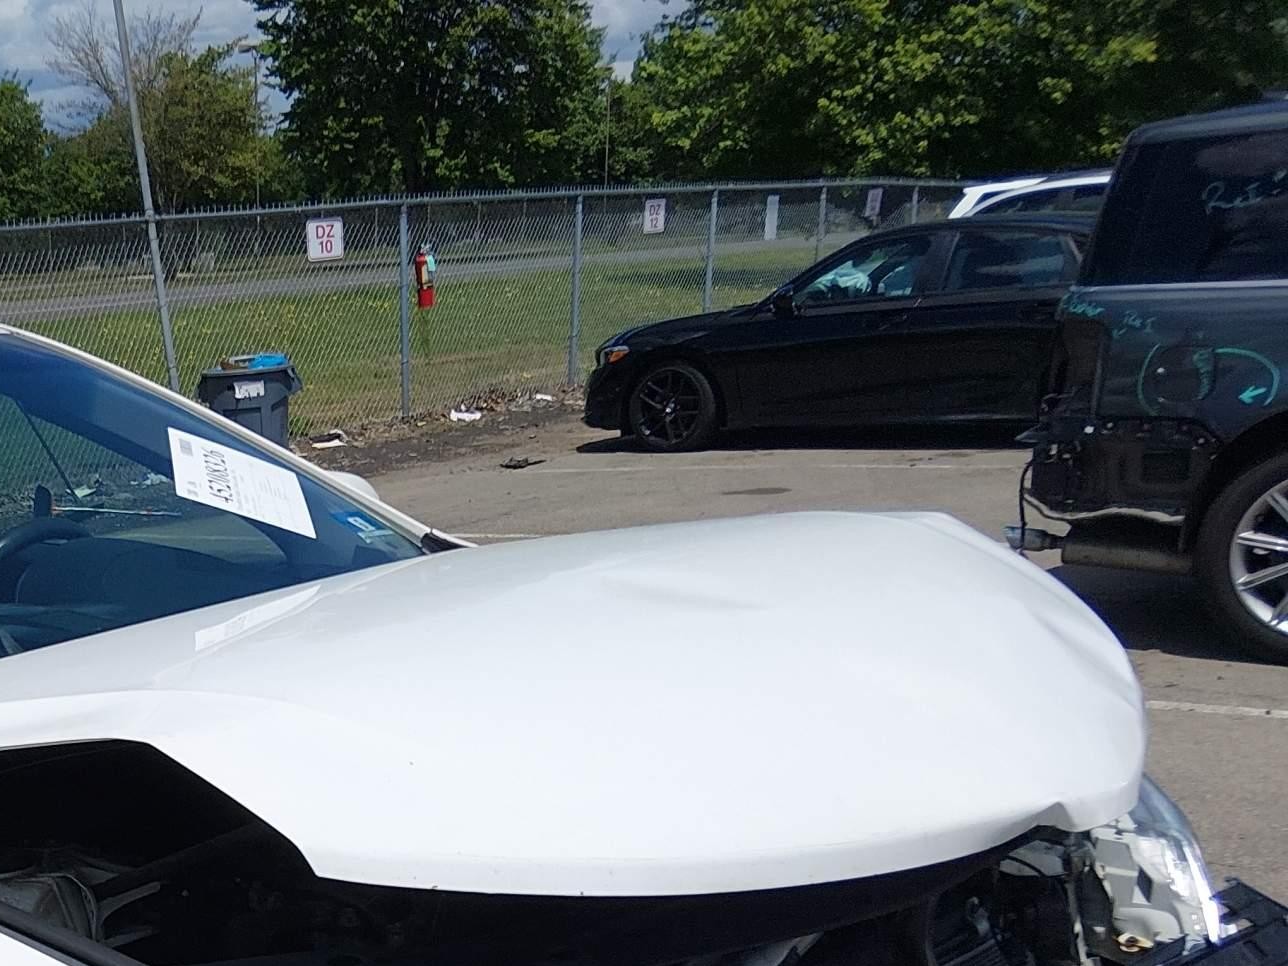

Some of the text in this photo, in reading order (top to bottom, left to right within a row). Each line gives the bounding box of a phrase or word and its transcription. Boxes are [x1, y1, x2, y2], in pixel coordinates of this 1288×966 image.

[649, 204, 661, 216] DZ
[650, 217, 658, 228] 12
[316, 225, 334, 239] DZ
[319, 240, 333, 253] 10
[202, 448, 233, 503] 45208326
